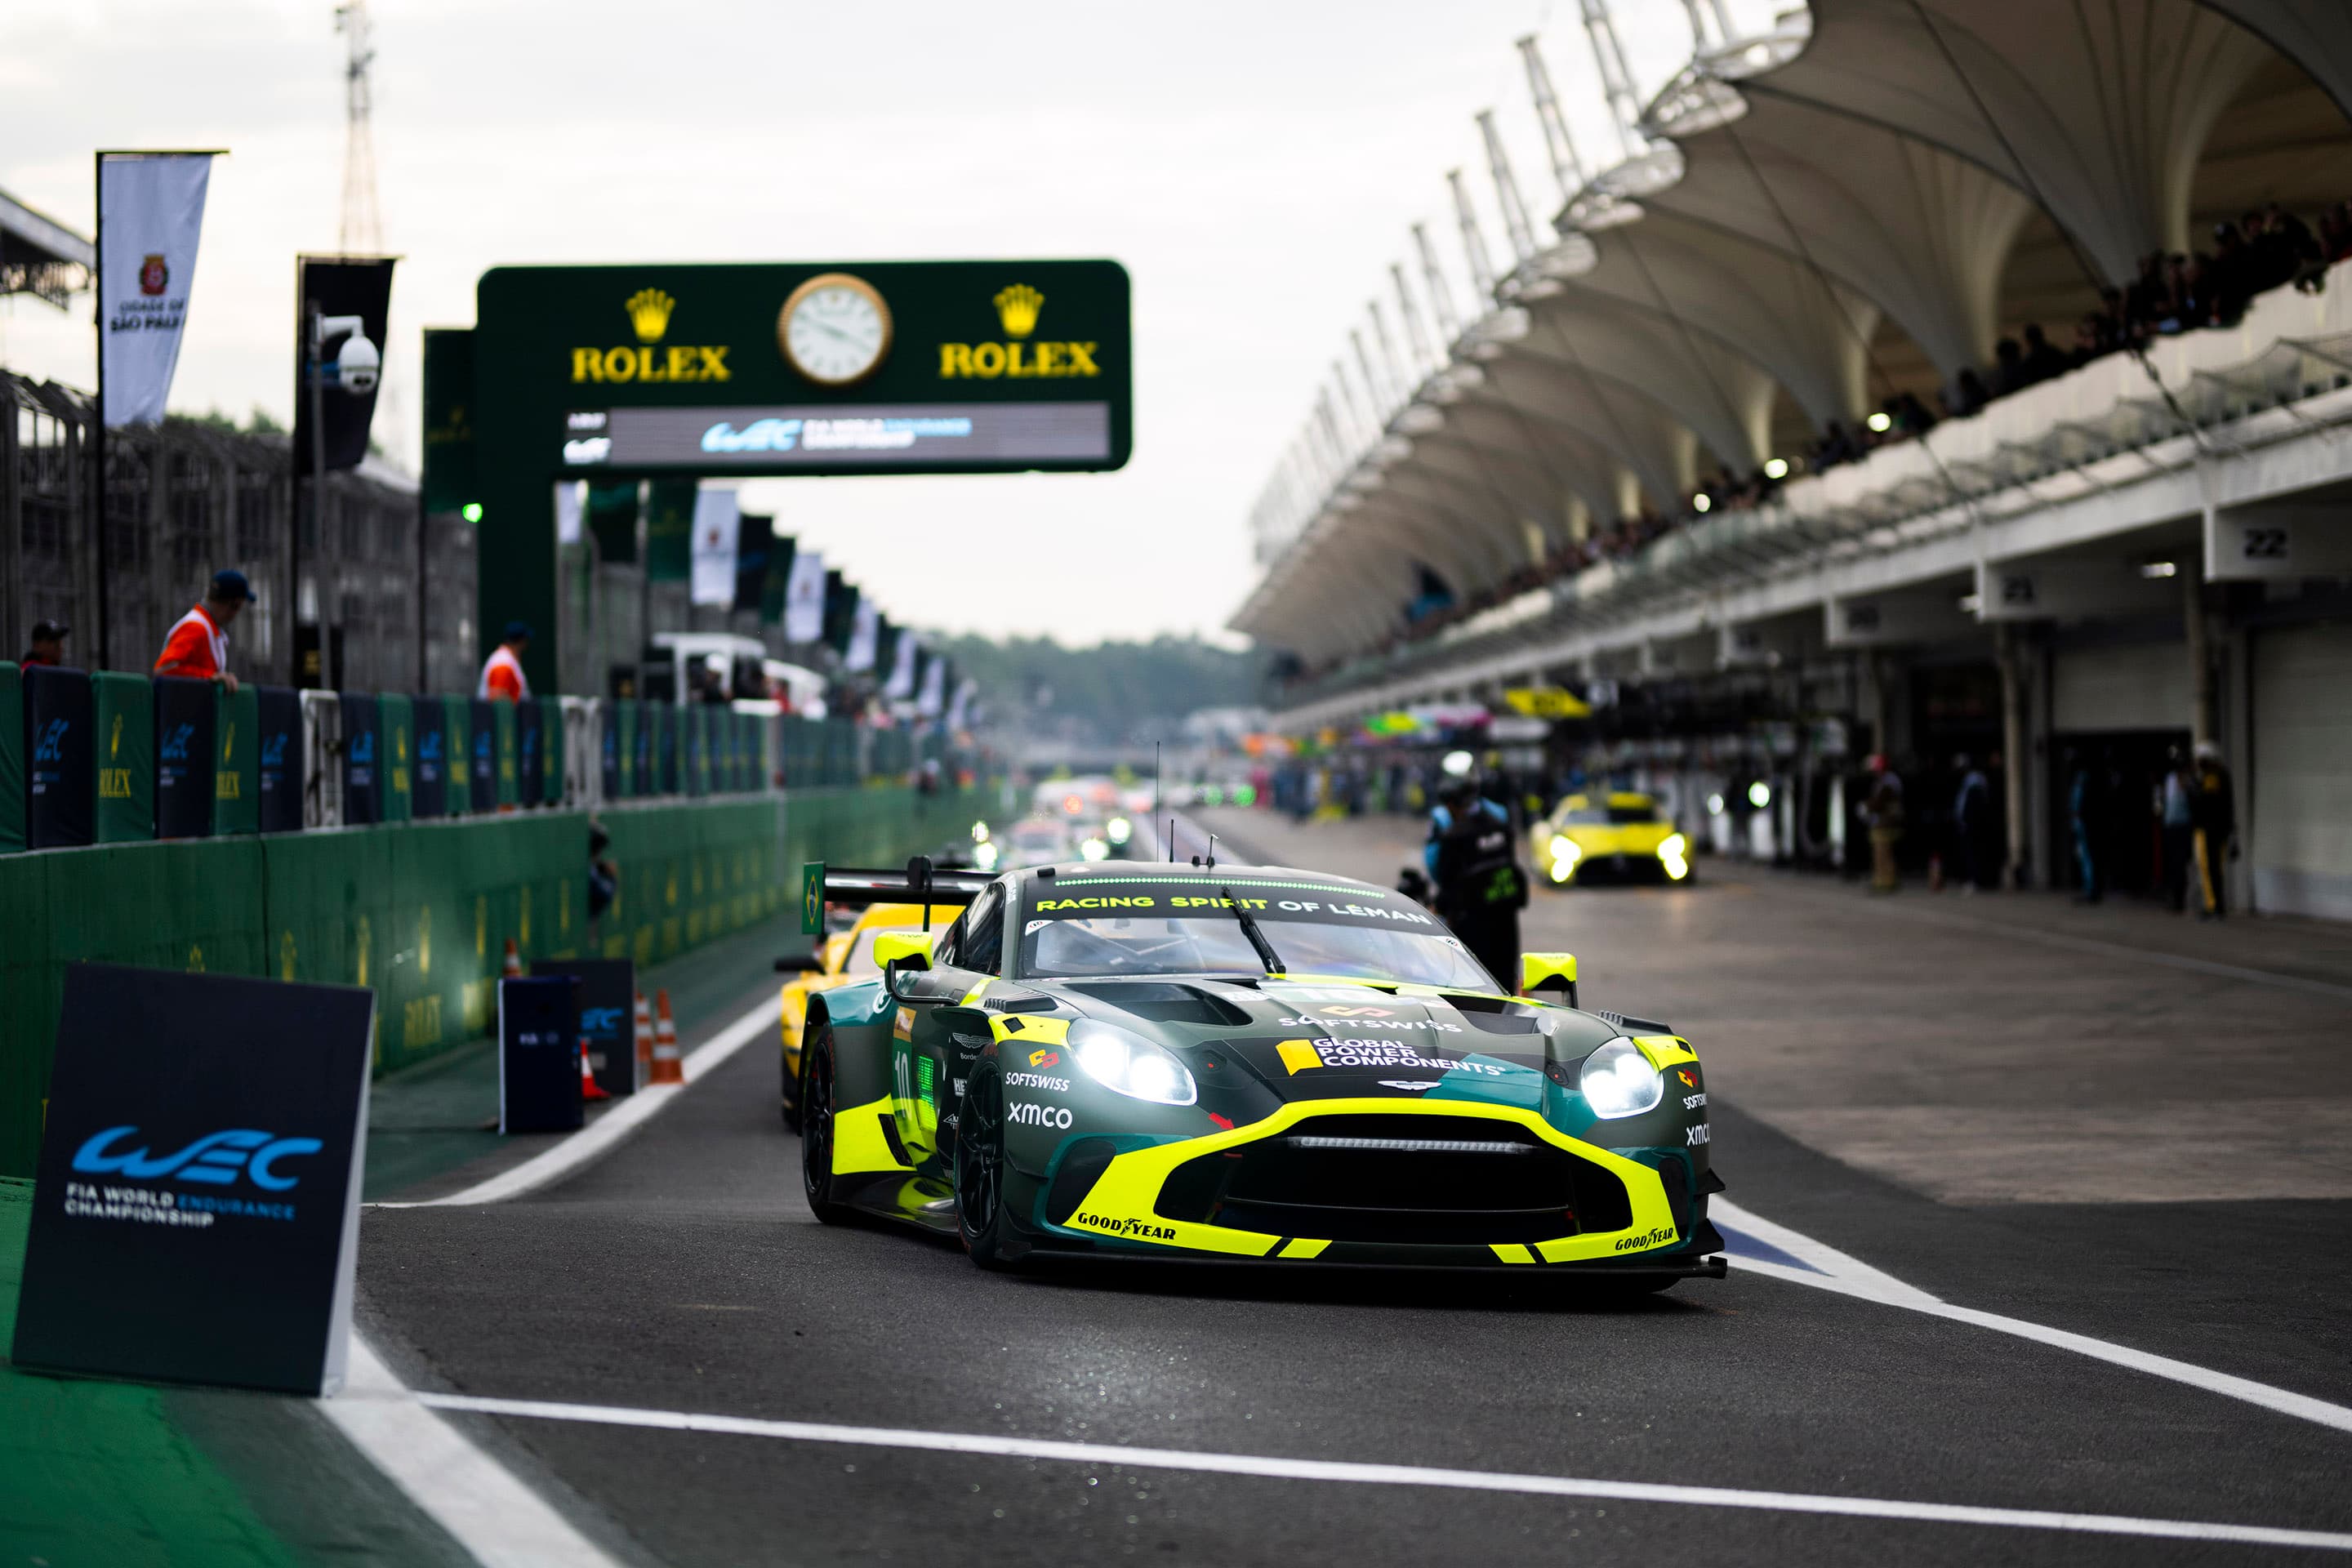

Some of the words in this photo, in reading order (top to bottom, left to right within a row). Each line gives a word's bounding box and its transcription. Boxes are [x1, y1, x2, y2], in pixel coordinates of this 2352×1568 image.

[572, 345, 730, 382] ROLEX
[940, 341, 1101, 377] ROLEX
[2244, 528, 2287, 559] 22
[1036, 897, 1156, 912] RACING
[1277, 900, 1321, 912] OF
[581, 1007, 624, 1031] EC
[1278, 1014, 1463, 1033] SOFTSWISS
[1312, 1038, 1413, 1049] GLOBAL
[1317, 1046, 1419, 1058] POWER
[960, 1052, 978, 1060] Borde
[1005, 1071, 1071, 1092] SOFTSWISS
[1683, 1094, 1708, 1110] SOFTS
[71, 1125, 324, 1192] WEC
[64, 1198, 216, 1228] CHAMPIONSHIP
[67, 1183, 98, 1200] FIA
[104, 1186, 175, 1208] WORLD
[177, 1192, 296, 1222] ENDURANCE
